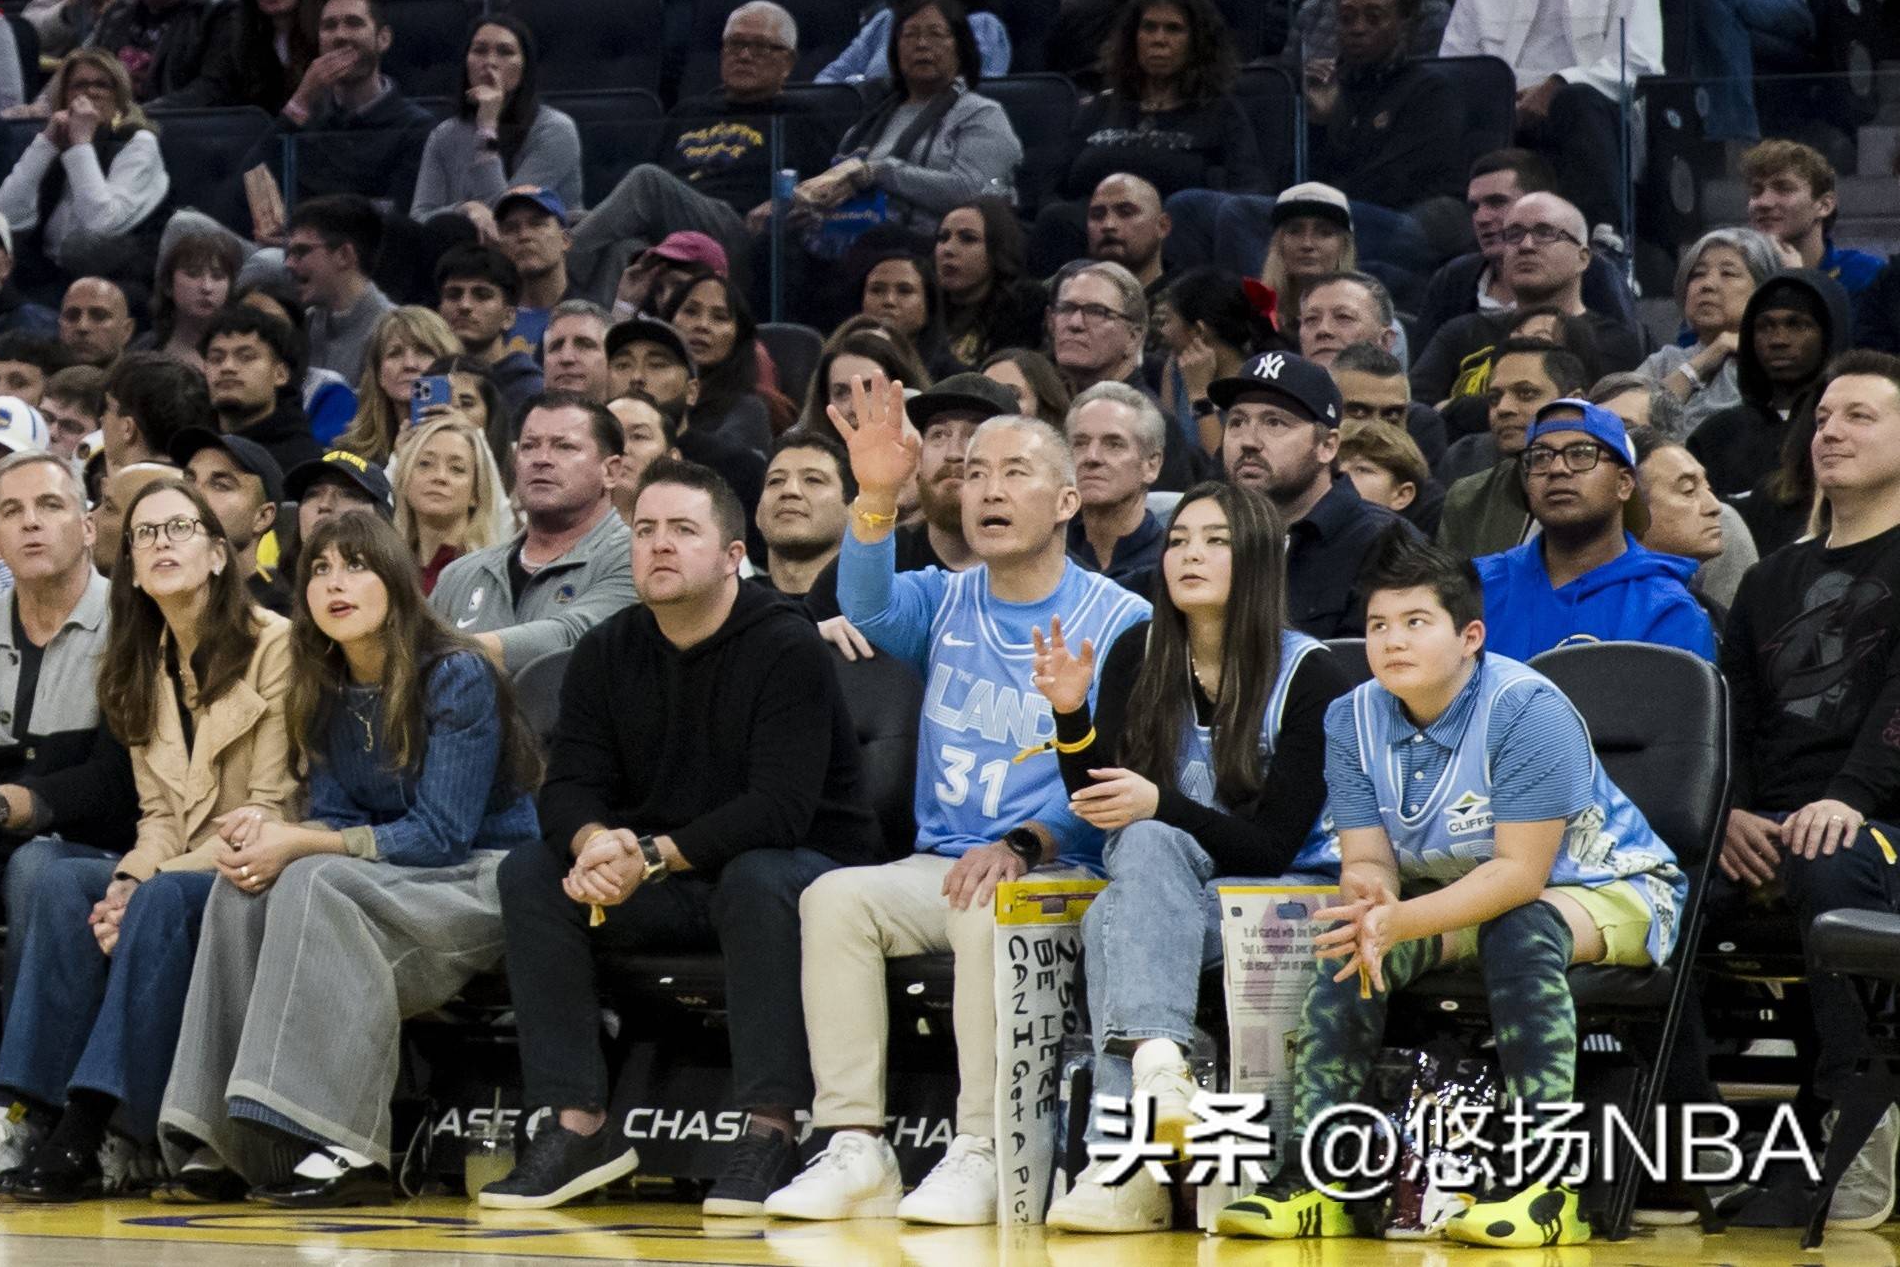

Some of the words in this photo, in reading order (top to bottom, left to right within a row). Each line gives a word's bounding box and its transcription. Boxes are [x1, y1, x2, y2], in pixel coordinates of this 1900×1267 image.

[1252, 352, 1286, 380] NY
[925, 662, 1057, 753] LAND
[935, 743, 1010, 820] 31
[1449, 814, 1494, 833] CLIFFS
[1008, 935, 1029, 1015] CAN
[1033, 938, 1055, 991] BE
[433, 1107, 522, 1139] ASE
